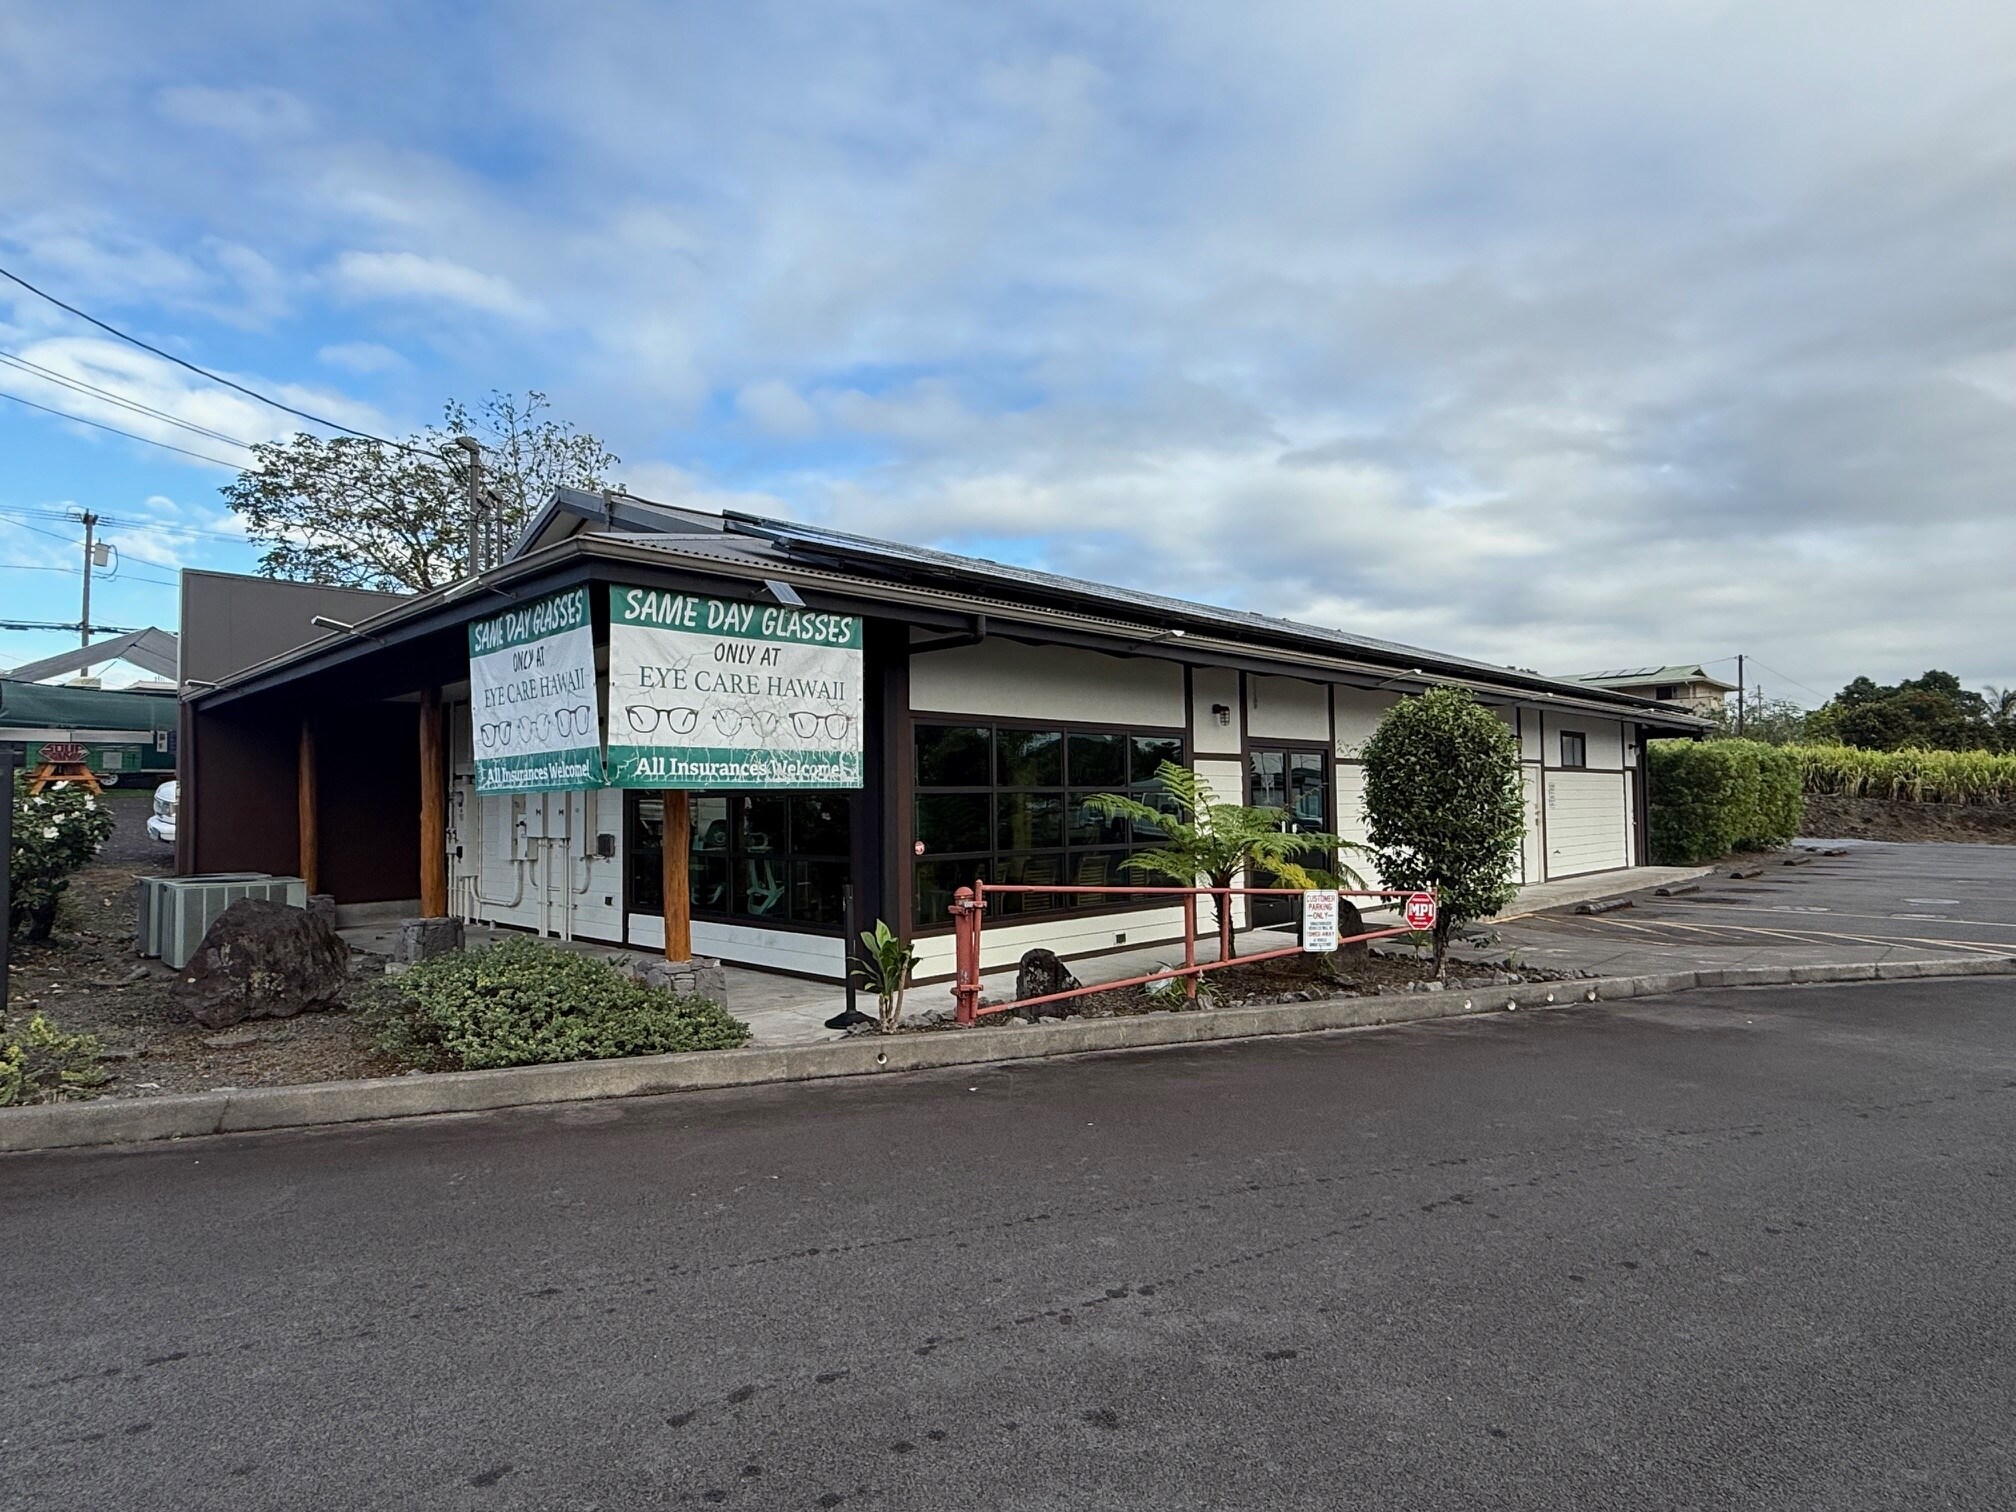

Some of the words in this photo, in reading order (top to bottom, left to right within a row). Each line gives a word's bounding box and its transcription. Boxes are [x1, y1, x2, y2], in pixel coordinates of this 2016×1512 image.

[475, 616, 504, 652] SAME
[505, 608, 532, 642] DAY
[533, 589, 583, 635] GLASSES
[624, 589, 699, 627] SAME
[707, 600, 754, 633] DAY
[762, 608, 853, 643] GLASSES
[512, 649, 534, 672] ONLY
[536, 646, 545, 668] AT
[713, 642, 756, 665] ONLY
[760, 647, 781, 667] AT
[484, 686, 506, 708] EYE
[507, 678, 538, 704] CARE
[540, 667, 585, 698] HAWAII
[639, 665, 688, 690] EYE
[694, 670, 761, 695] CARE
[767, 676, 845, 701] HAWAII
[487, 766, 501, 784] All
[501, 766, 548, 782] Insurances
[548, 759, 590, 779] Welcome!
[635, 756, 664, 776] All
[670, 758, 767, 777] Insurances
[1308, 903, 1333, 911] PARKING
[1408, 902, 1434, 917] MPI
